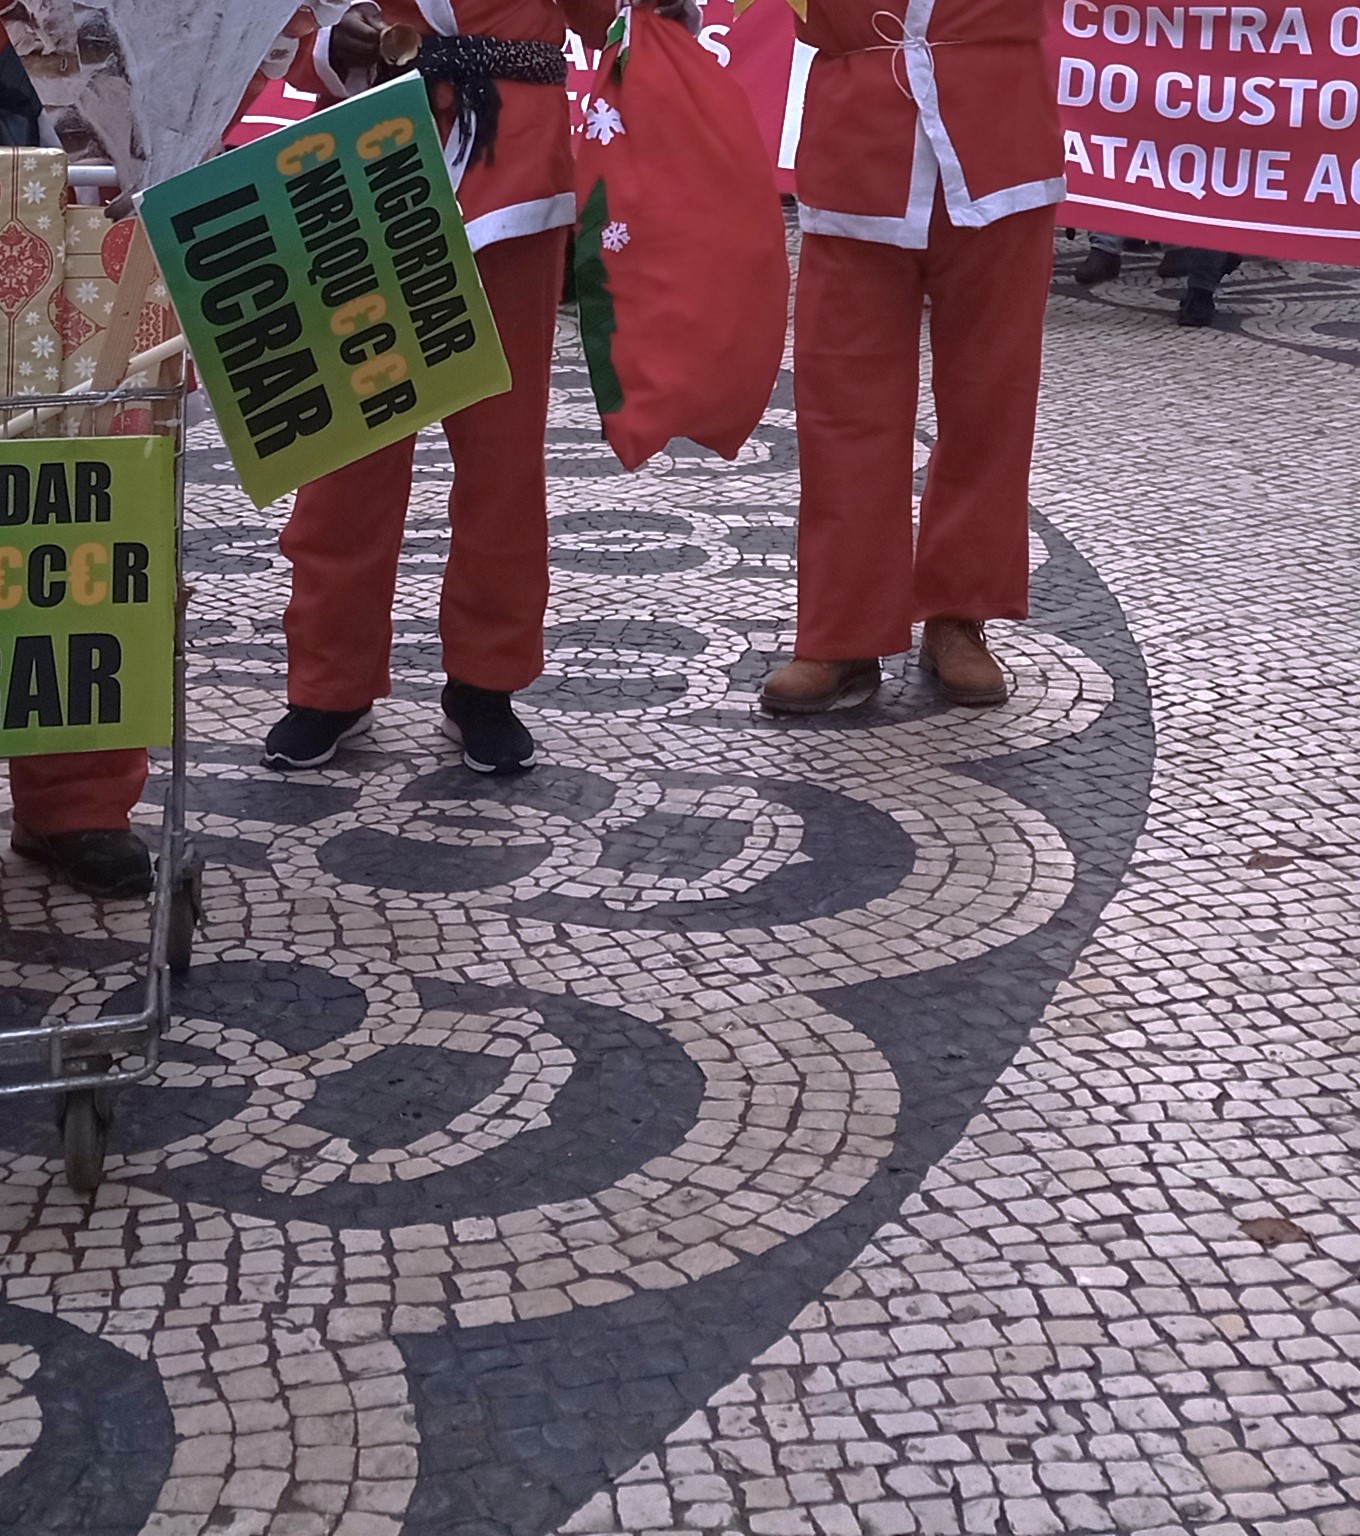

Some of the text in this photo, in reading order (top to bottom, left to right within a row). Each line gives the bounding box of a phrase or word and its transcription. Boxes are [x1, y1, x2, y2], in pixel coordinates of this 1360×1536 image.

[1057, 56, 1139, 113] DO
[1154, 71, 1359, 130] CUSTO
[1063, 129, 1291, 200] ATAQUE
[169, 182, 334, 460] LUCRAR
